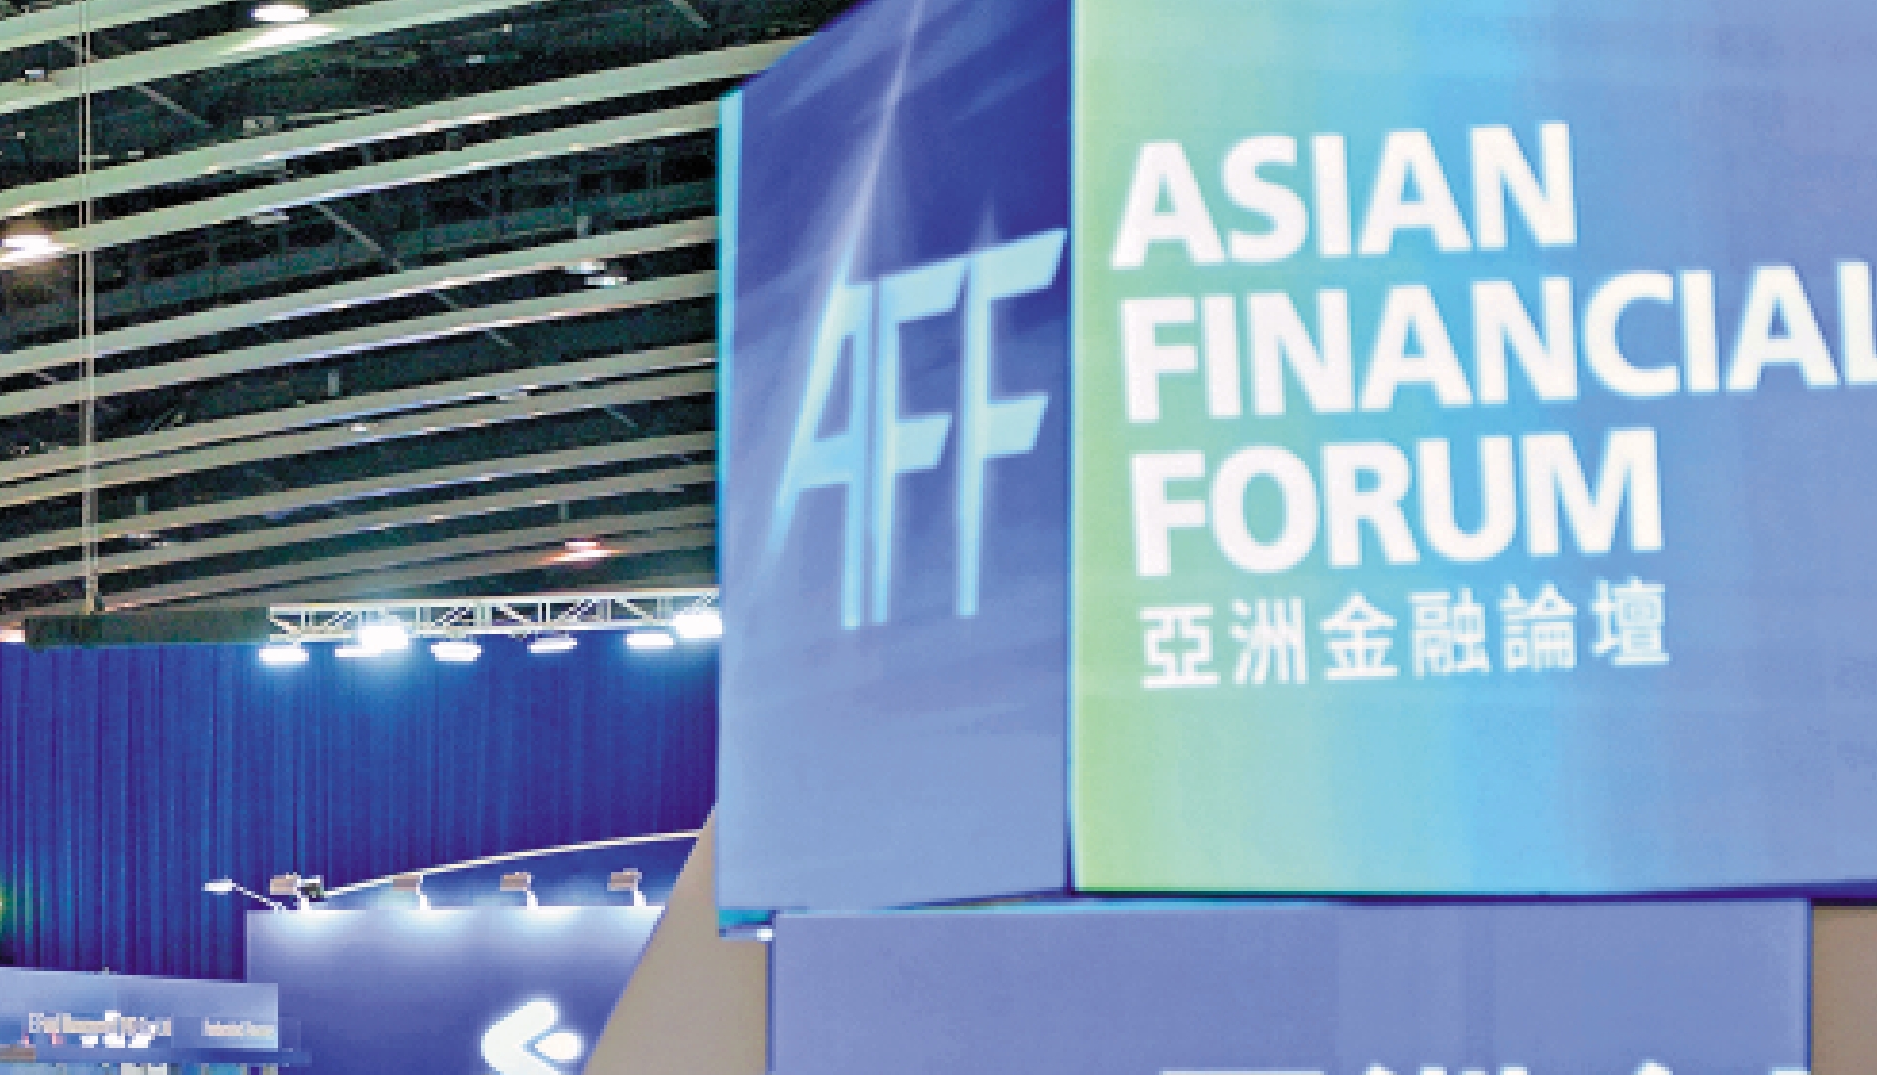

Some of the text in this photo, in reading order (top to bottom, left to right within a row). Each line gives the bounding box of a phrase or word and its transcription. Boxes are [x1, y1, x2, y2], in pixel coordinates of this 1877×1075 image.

[1111, 123, 1577, 271] ASIAN
[1120, 261, 1877, 422] FINANCIAL
[763, 228, 1068, 630] AFF
[1129, 427, 1665, 578] FORUM
[1139, 578, 1671, 690] 亞洲金融論壇
